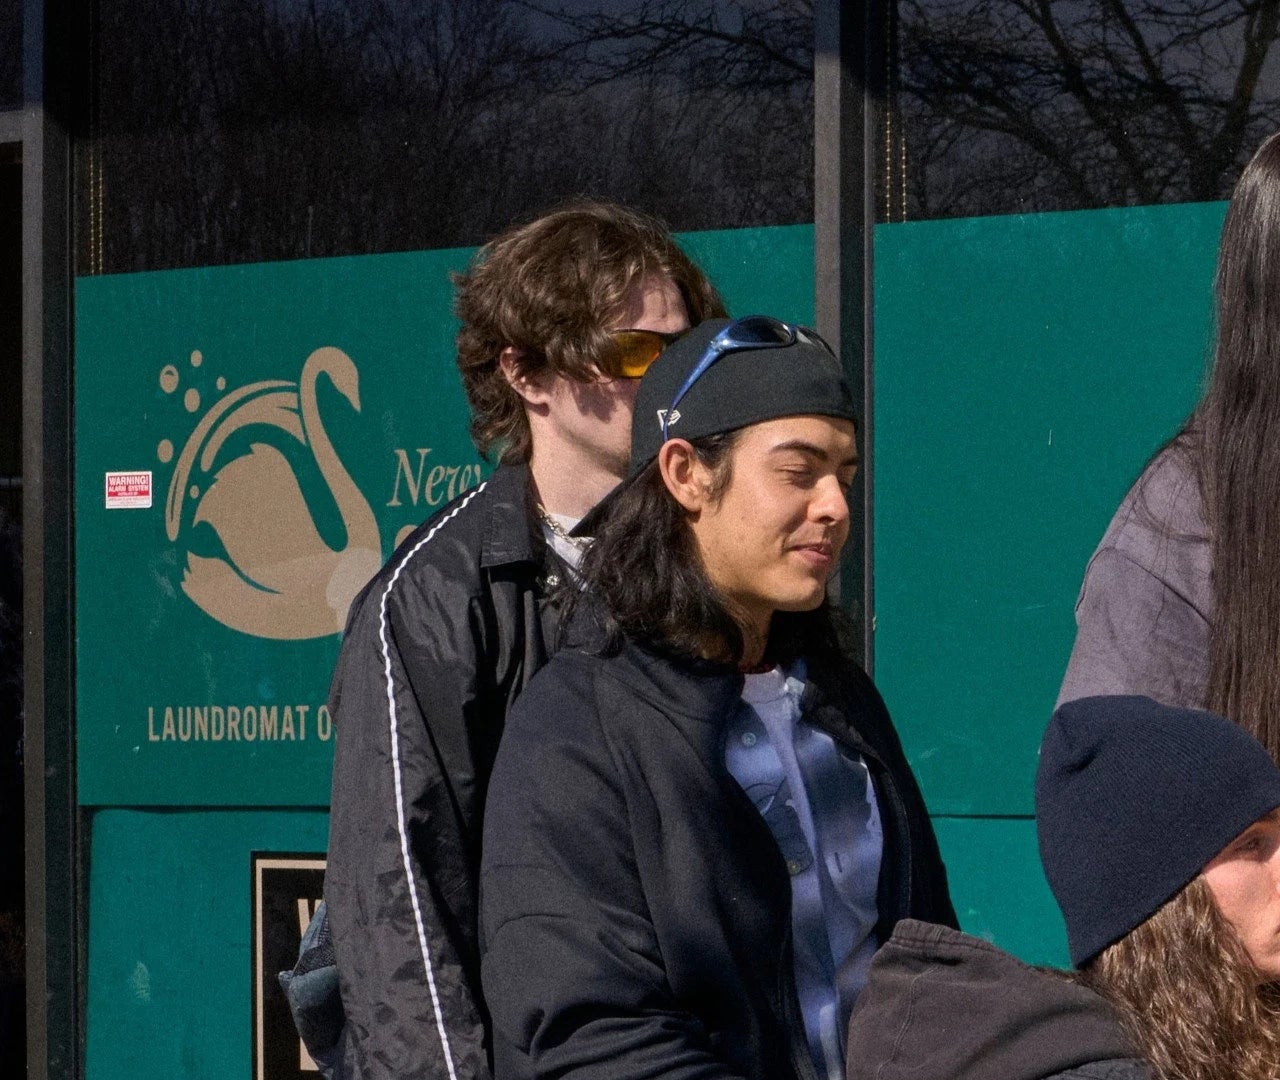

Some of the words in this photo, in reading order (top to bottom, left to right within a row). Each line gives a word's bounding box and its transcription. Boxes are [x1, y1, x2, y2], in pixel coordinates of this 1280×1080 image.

[109, 476, 149, 485] WARNING!
[148, 704, 310, 742] LAUNDROMAT
[317, 704, 333, 742] O
